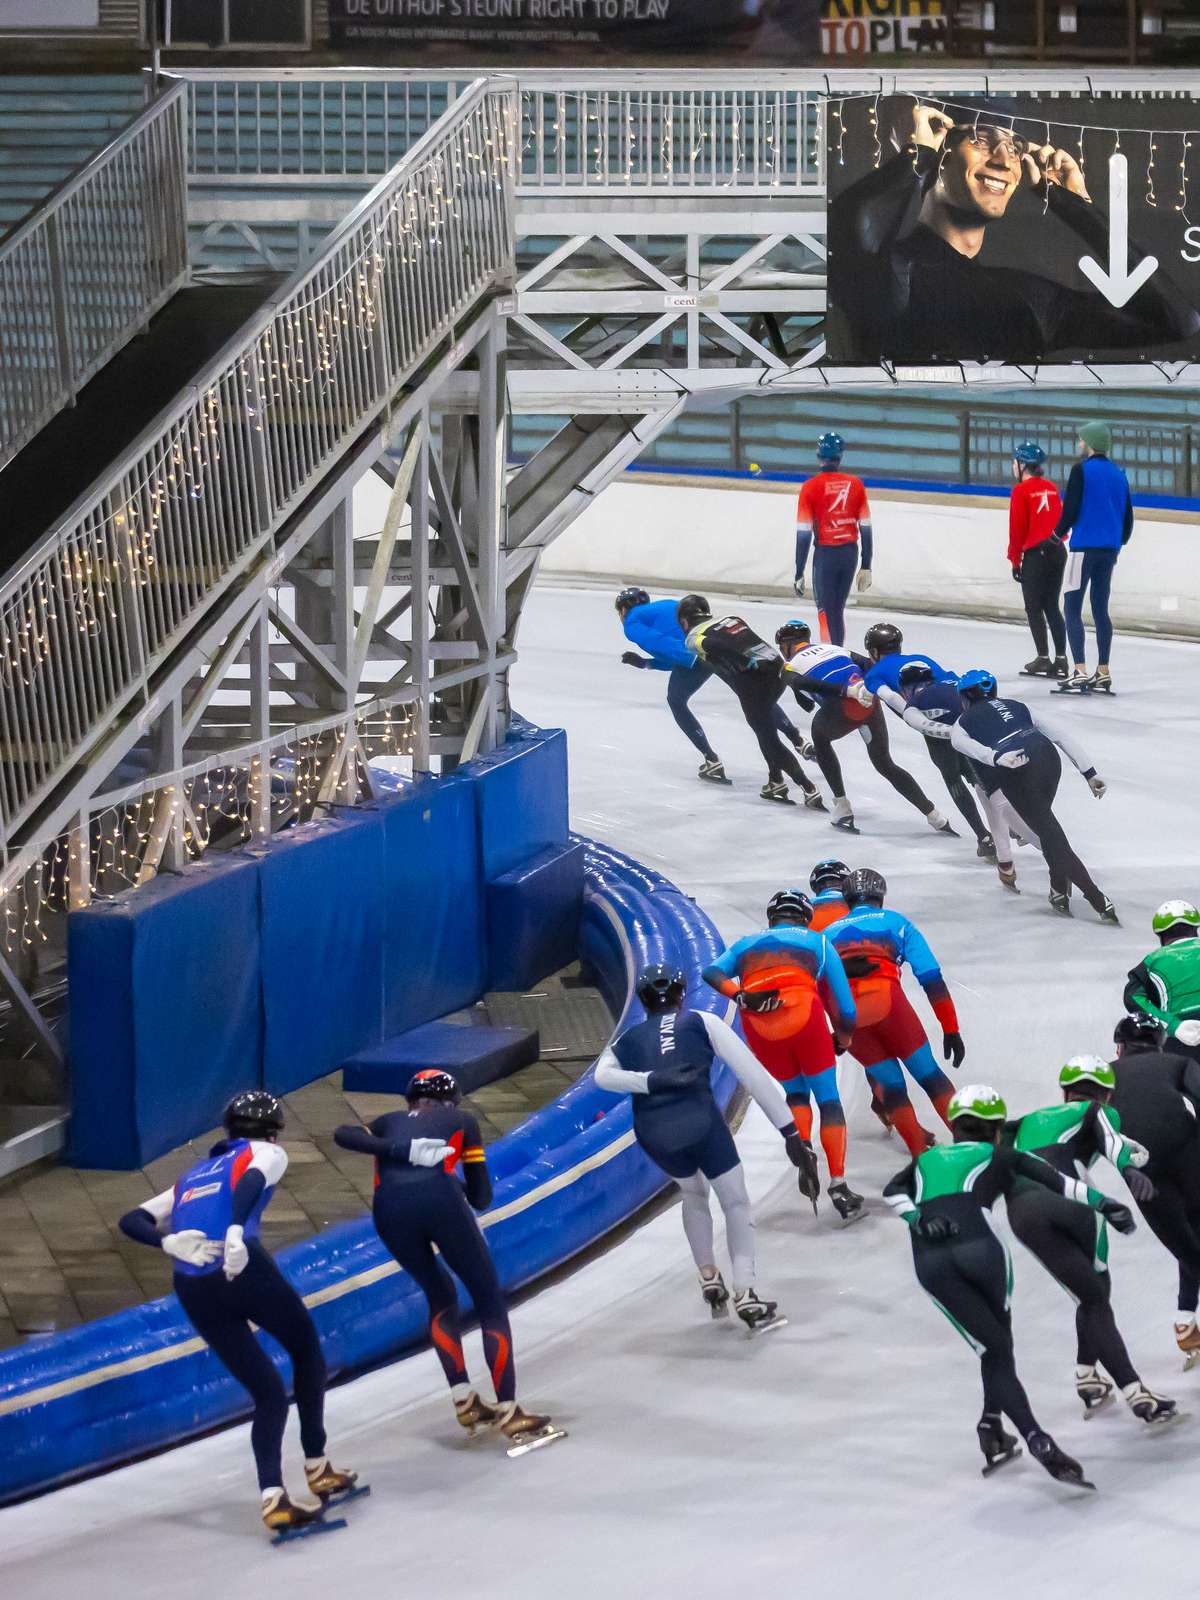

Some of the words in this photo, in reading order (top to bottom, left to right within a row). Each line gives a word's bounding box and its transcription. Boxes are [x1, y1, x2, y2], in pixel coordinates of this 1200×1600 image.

[376, 0, 445, 16] UITHOF
[450, 0, 521, 17] STEUNT
[530, 0, 586, 18] RIGHT
[595, 0, 618, 18] TO
[623, 0, 669, 19] PLAY
